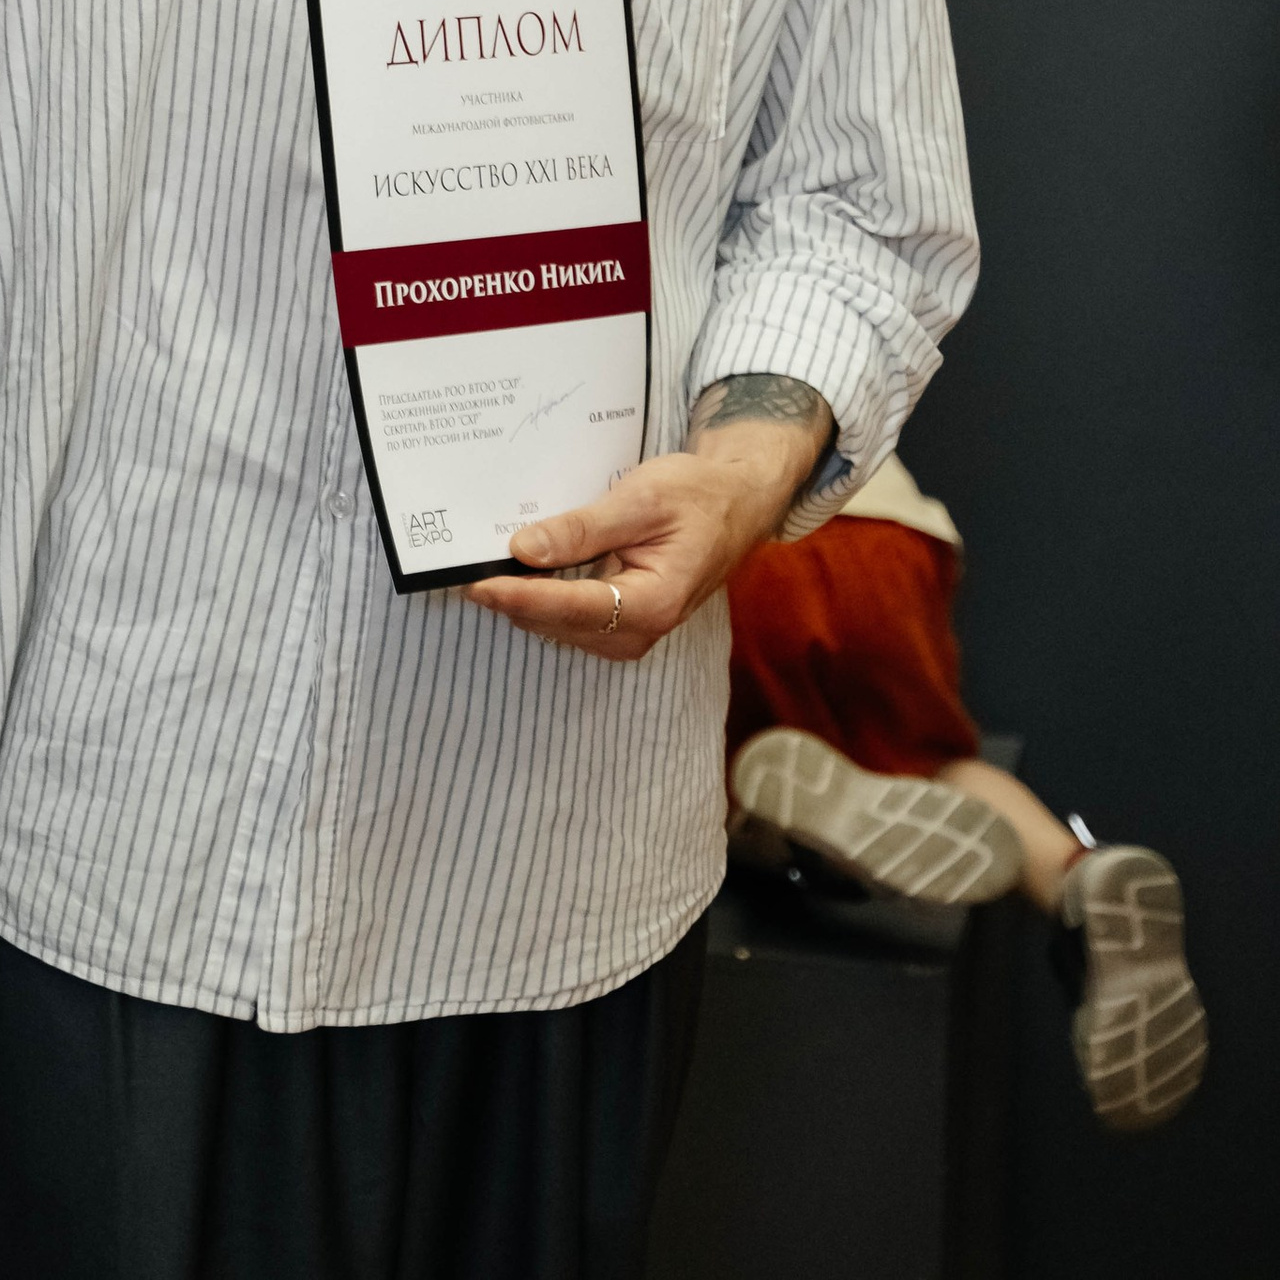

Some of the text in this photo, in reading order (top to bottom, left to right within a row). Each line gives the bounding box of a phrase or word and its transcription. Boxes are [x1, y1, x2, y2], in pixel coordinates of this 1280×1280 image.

[386, 9, 586, 69] ДИПЛОМ
[460, 91, 524, 106] УЧАСТНИКА
[373, 154, 614, 199] ИСКУССТВО XXI ВЕКА
[444, 385, 466, 398] РОО
[468, 381, 496, 395] ВТОО
[501, 393, 516, 405] РФ
[429, 416, 456, 430] ВТОО
[409, 509, 448, 532] ART
[410, 528, 453, 548] EXPO
